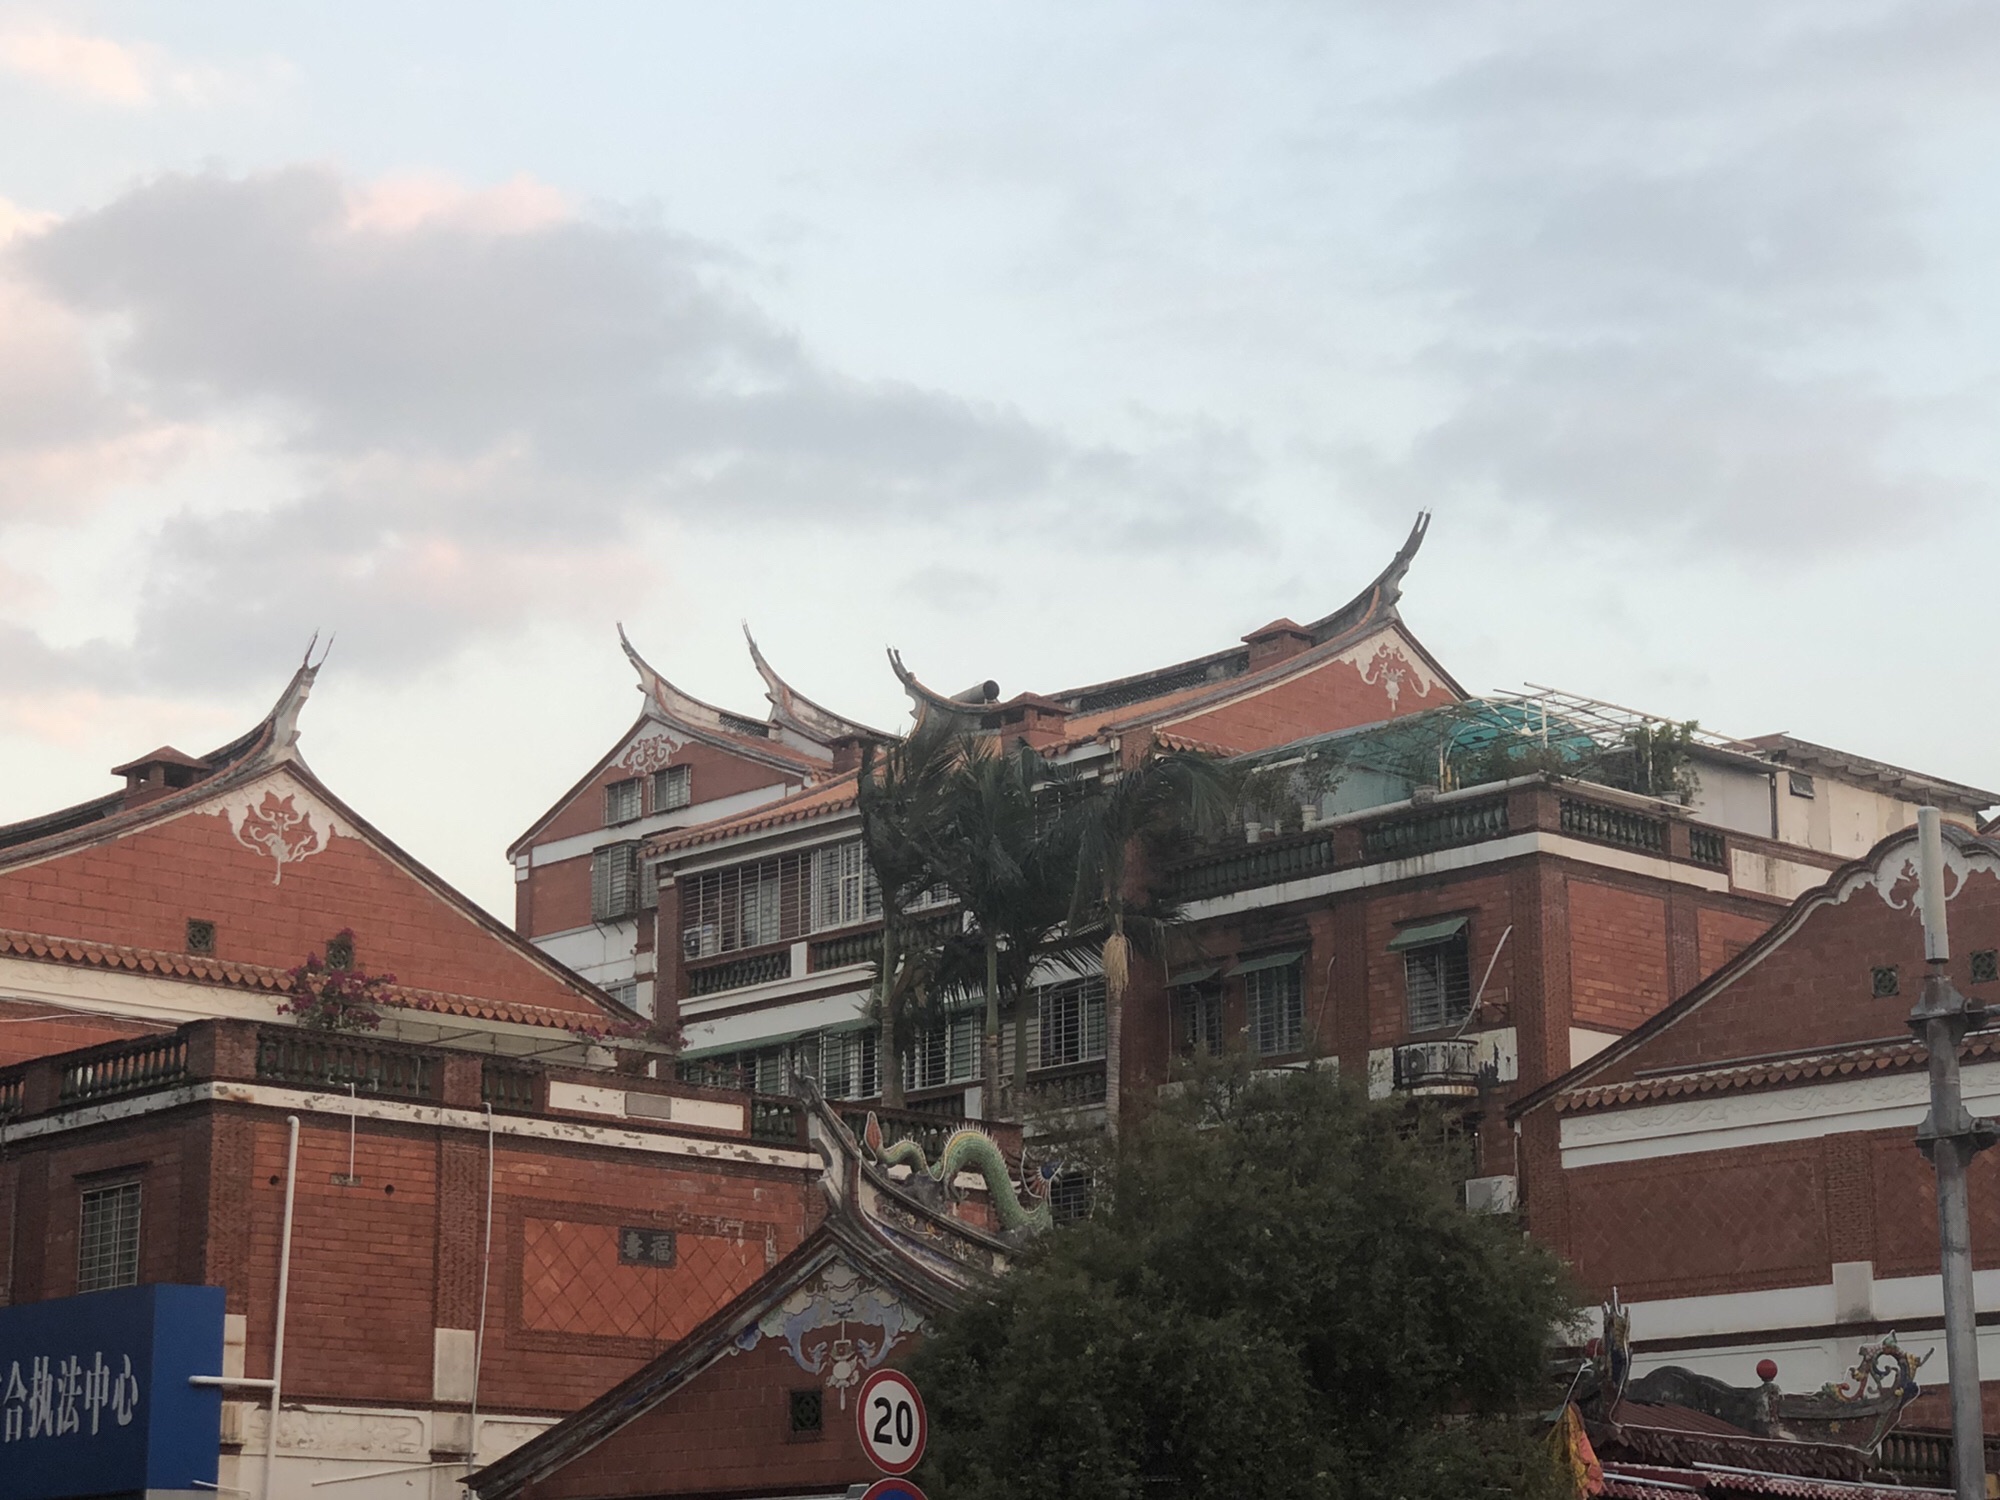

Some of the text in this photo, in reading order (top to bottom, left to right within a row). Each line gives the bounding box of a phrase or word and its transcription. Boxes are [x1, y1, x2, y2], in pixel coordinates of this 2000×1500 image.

[0, 1351, 139, 1443] 合执法中心
[873, 1397, 913, 1447] 20
